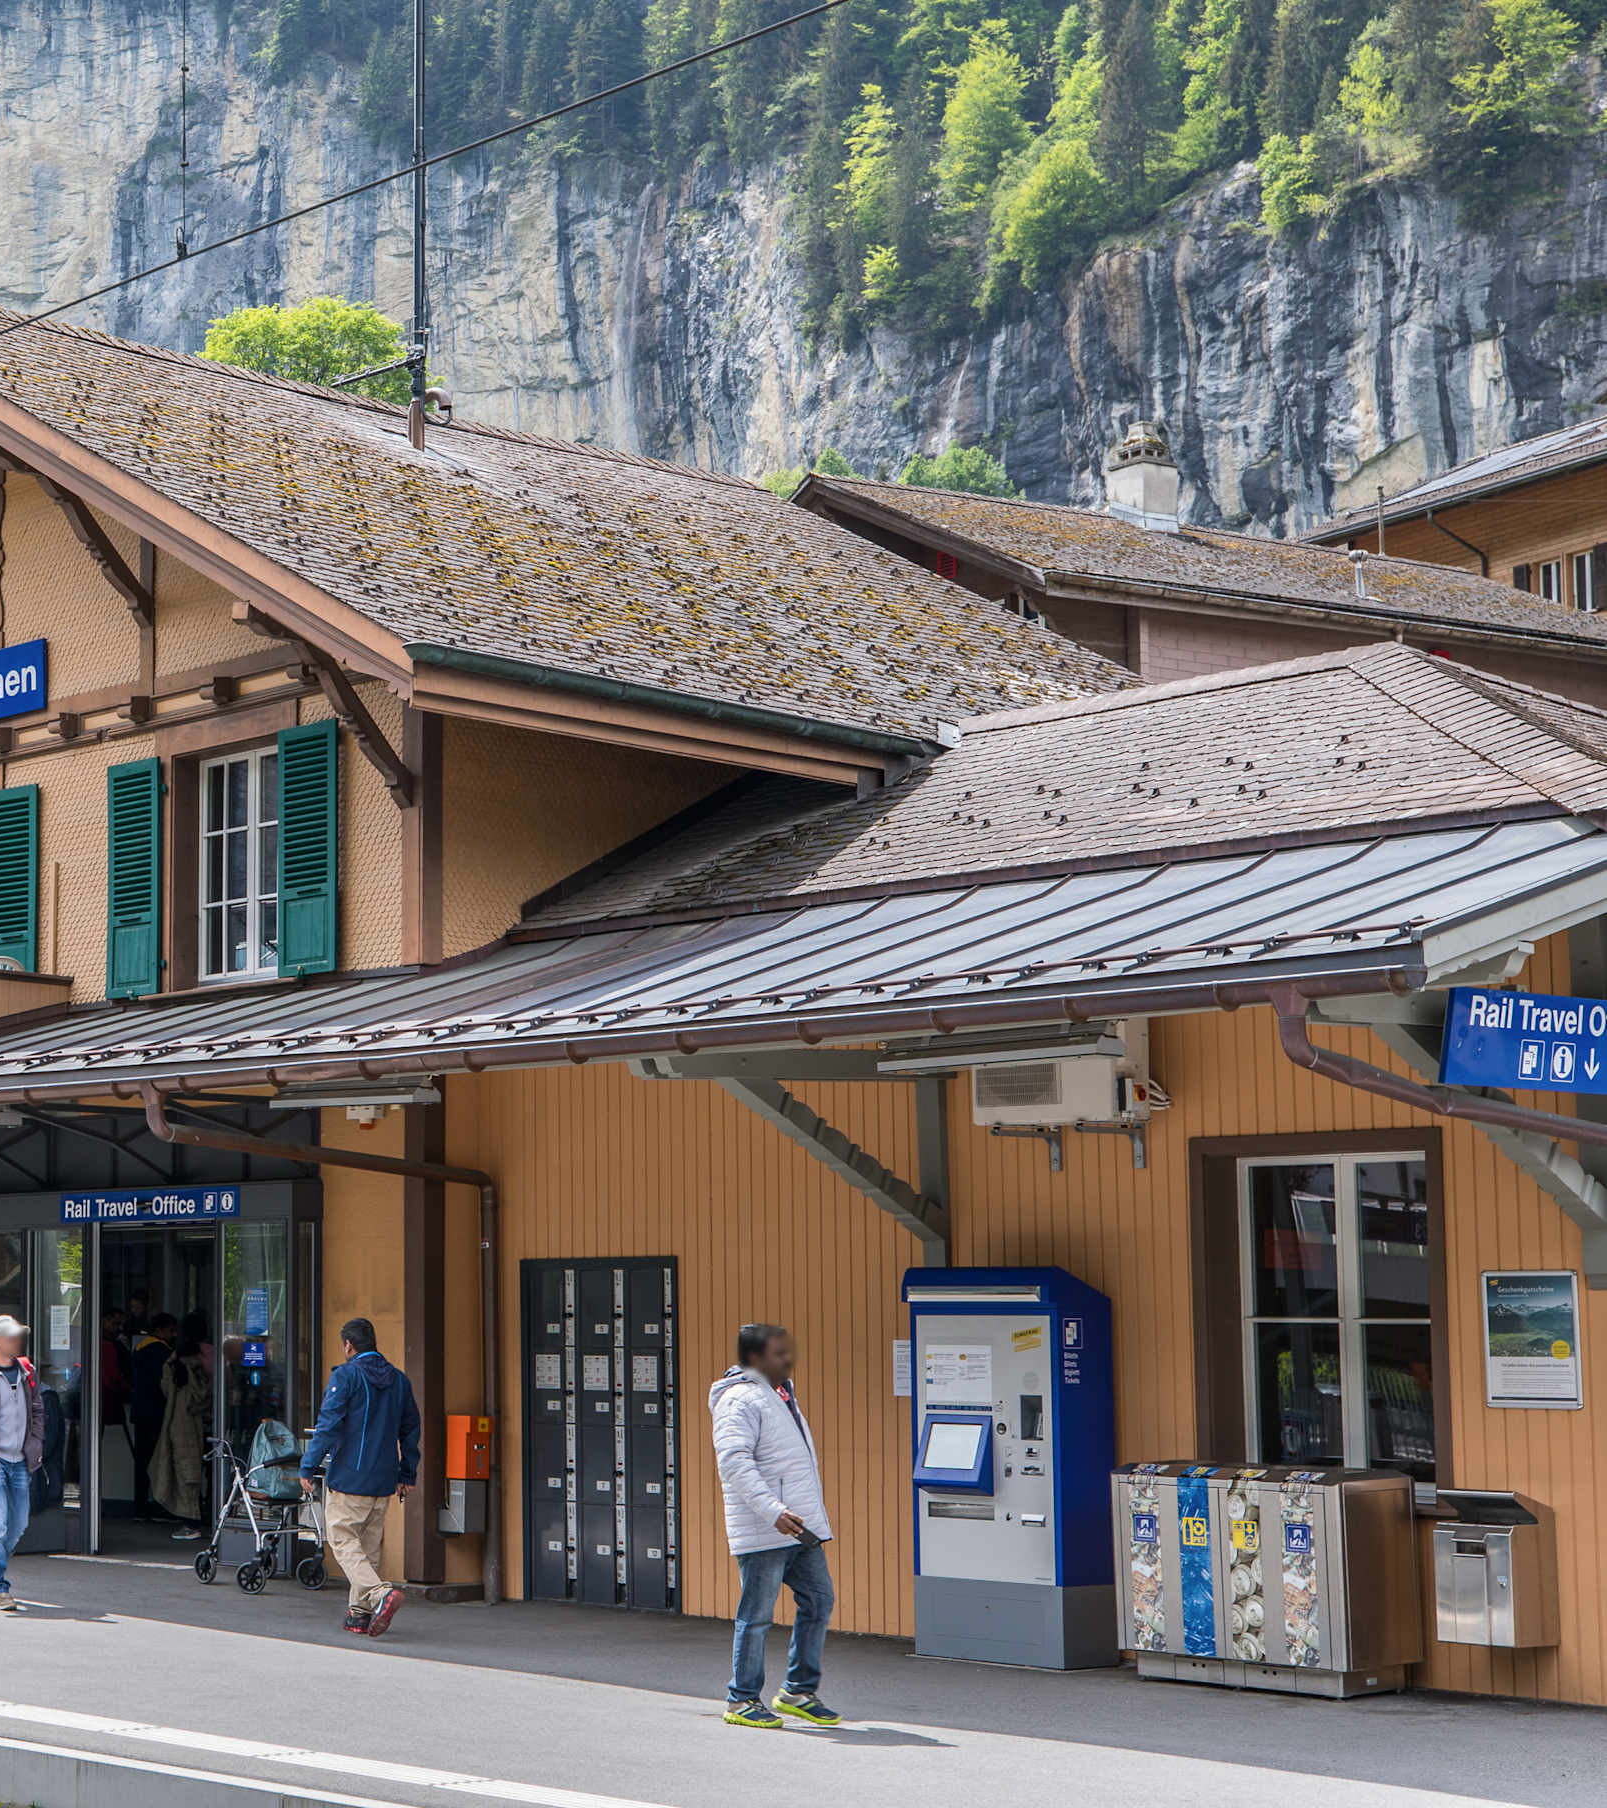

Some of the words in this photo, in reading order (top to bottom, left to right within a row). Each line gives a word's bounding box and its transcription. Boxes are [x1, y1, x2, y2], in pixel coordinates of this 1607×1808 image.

[1469, 994, 1514, 1029] Rail
[1519, 999, 1584, 1035] Travel
[1588, 1005, 1607, 1038] O
[64, 1199, 91, 1218] Rail
[95, 1197, 138, 1217] Travel
[151, 1195, 196, 1215] Office
